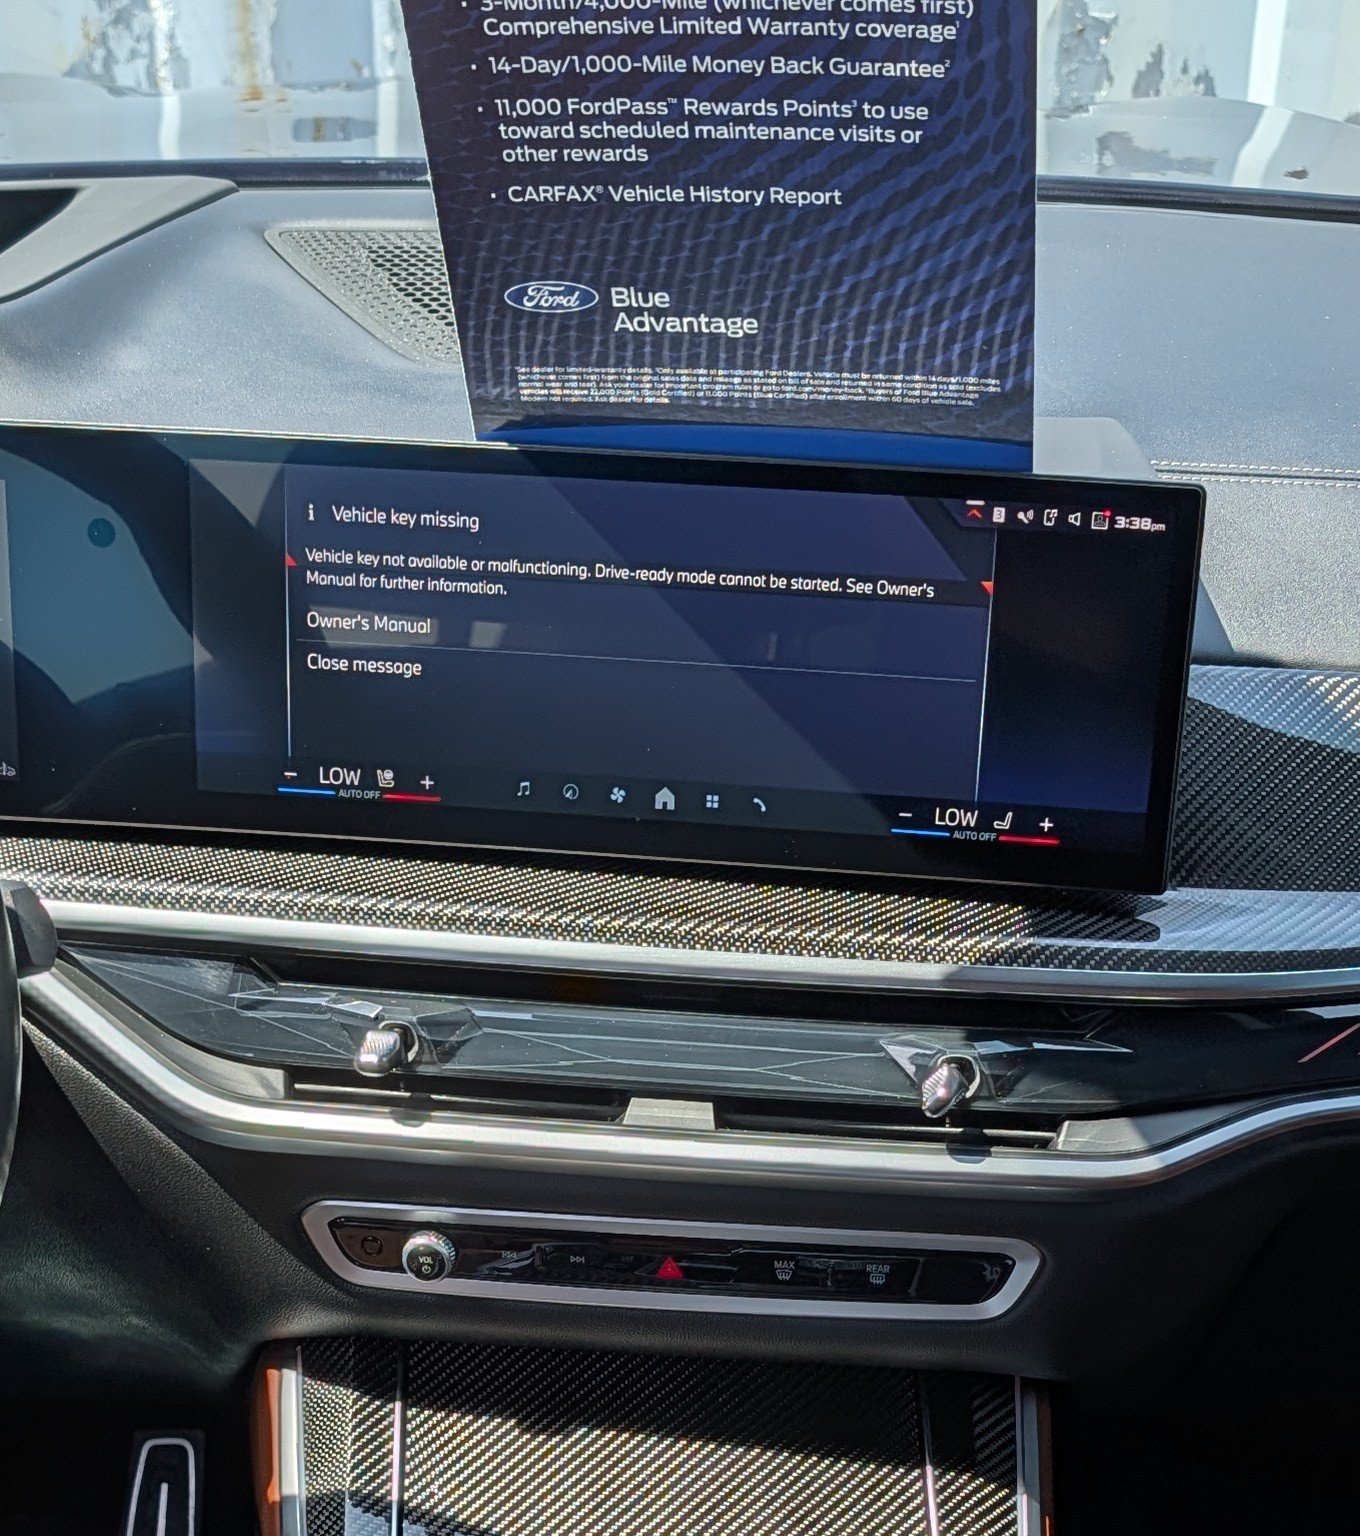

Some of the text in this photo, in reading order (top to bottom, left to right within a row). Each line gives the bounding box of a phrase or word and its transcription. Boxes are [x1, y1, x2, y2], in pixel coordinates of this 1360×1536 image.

[841, 0, 915, 14] comes
[921, 0, 973, 18] first)
[484, 16, 654, 38] Comprehensive
[660, 16, 741, 35] Limited
[747, 17, 850, 40] Warranty
[488, 55, 686, 76] 14-Day/1,000-Mile
[693, 56, 765, 76] Money
[771, 56, 824, 75] Back
[494, 98, 561, 118] 11,000
[684, 98, 778, 116] Rewards
[862, 102, 885, 118] to
[891, 105, 928, 120] use
[498, 121, 923, 144] toward scheduled maintenance visits or
[503, 144, 648, 162] other rewards
[608, 185, 685, 202] Vehicle
[690, 186, 765, 207] History
[770, 187, 842, 207] Report
[611, 287, 671, 308] Blue
[614, 311, 759, 338] Advantage
[332, 505, 387, 525] Vehicle
[391, 509, 416, 530] key
[420, 511, 480, 533] missing
[305, 547, 935, 598] Vehicle key not available or malfunctioning. Drive-ready mode cannot be started. See Owner's
[307, 569, 507, 596] Manual for further information.
[307, 611, 431, 634] Owner's Manual
[307, 653, 422, 679] Close message
[319, 766, 361, 786] LOW
[338, 788, 381, 800] AUTO OFF
[935, 807, 978, 828] LOW
[953, 830, 997, 842] AUTO OFF
[418, 1255, 434, 1264] VOL
[773, 1260, 796, 1270] MAX
[866, 1264, 891, 1273] REAR
